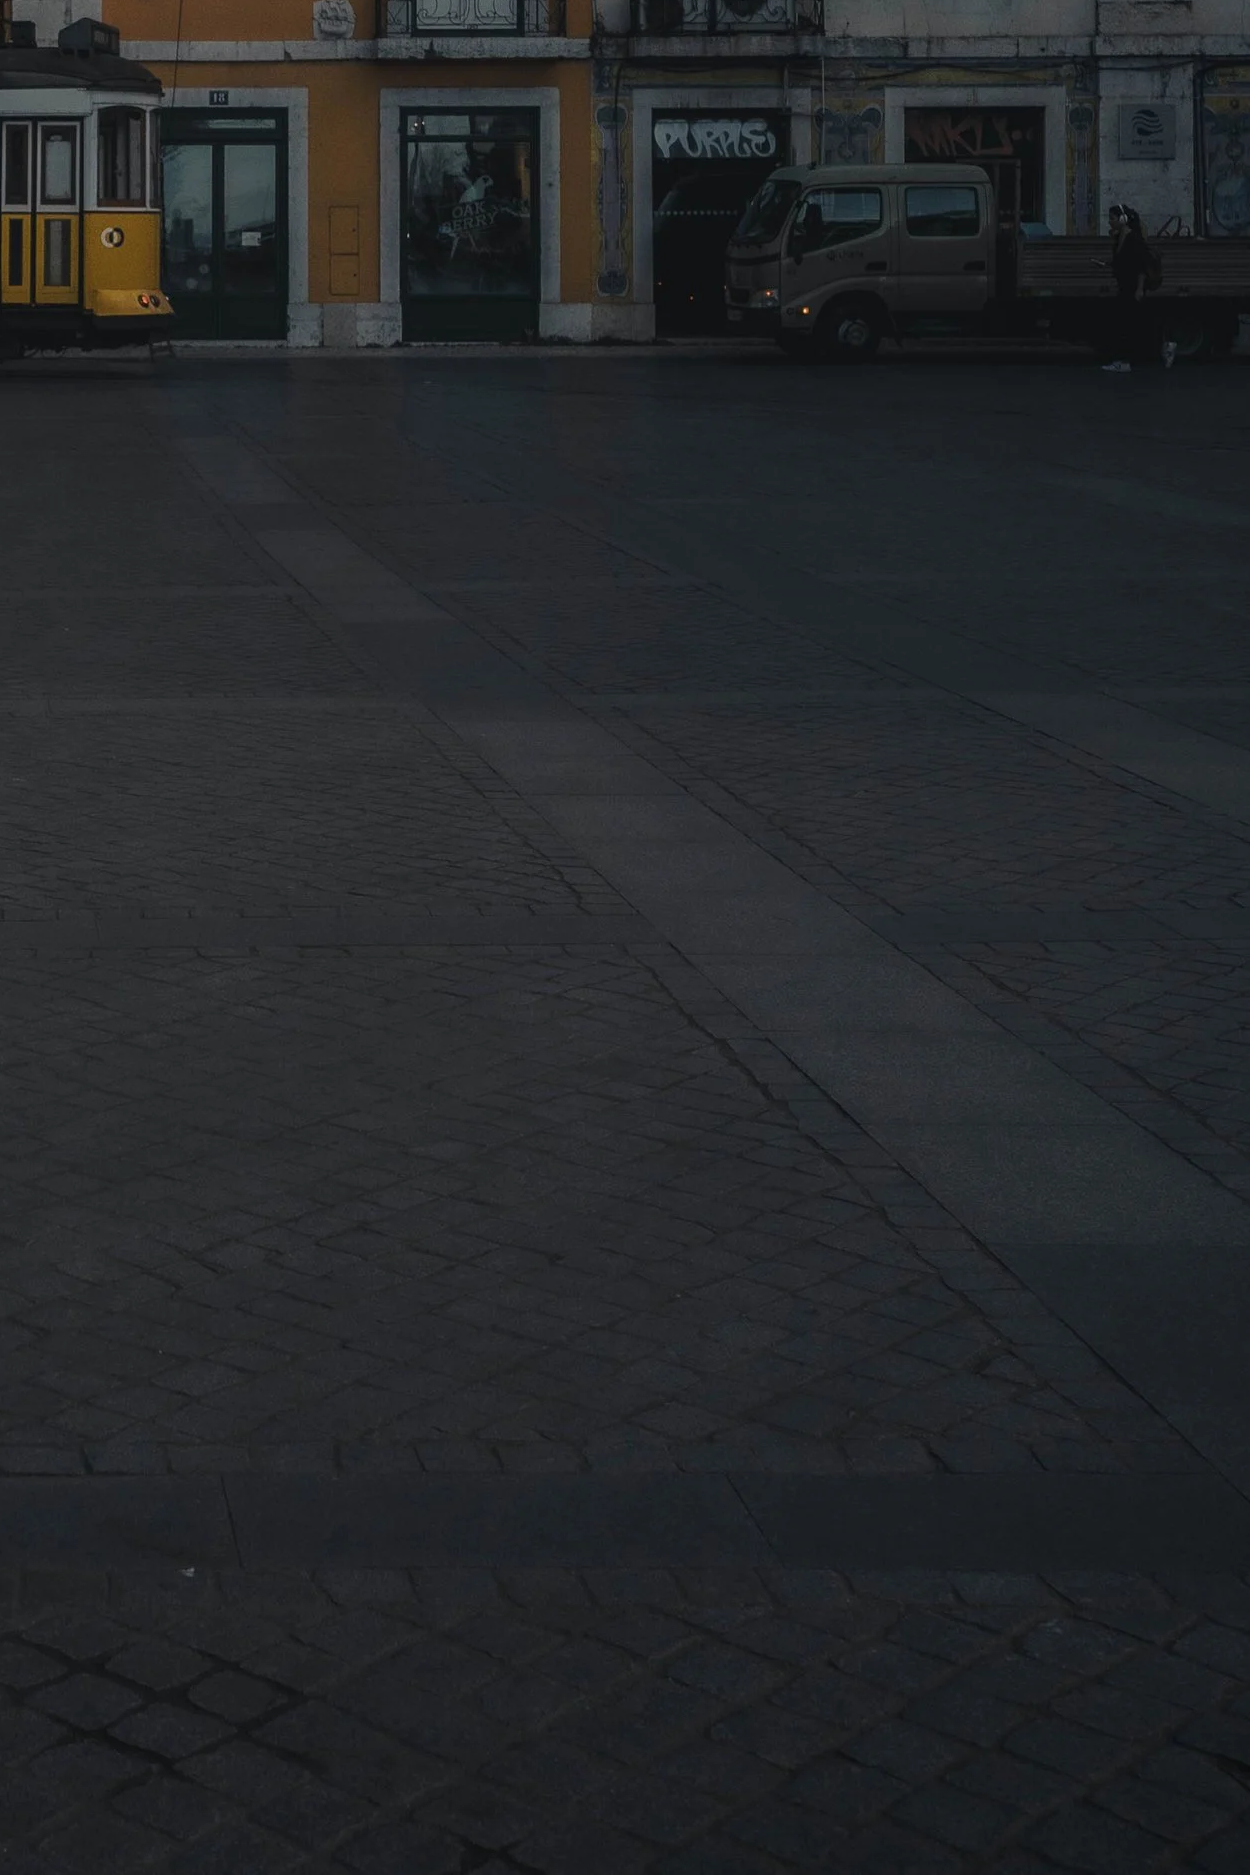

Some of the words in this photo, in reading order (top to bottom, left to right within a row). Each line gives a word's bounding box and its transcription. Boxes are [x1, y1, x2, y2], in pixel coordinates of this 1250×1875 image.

[213, 92, 225, 104] 18
[654, 118, 775, 158] PURPLE
[452, 201, 486, 219] OAK
[442, 211, 498, 233] BERRY
